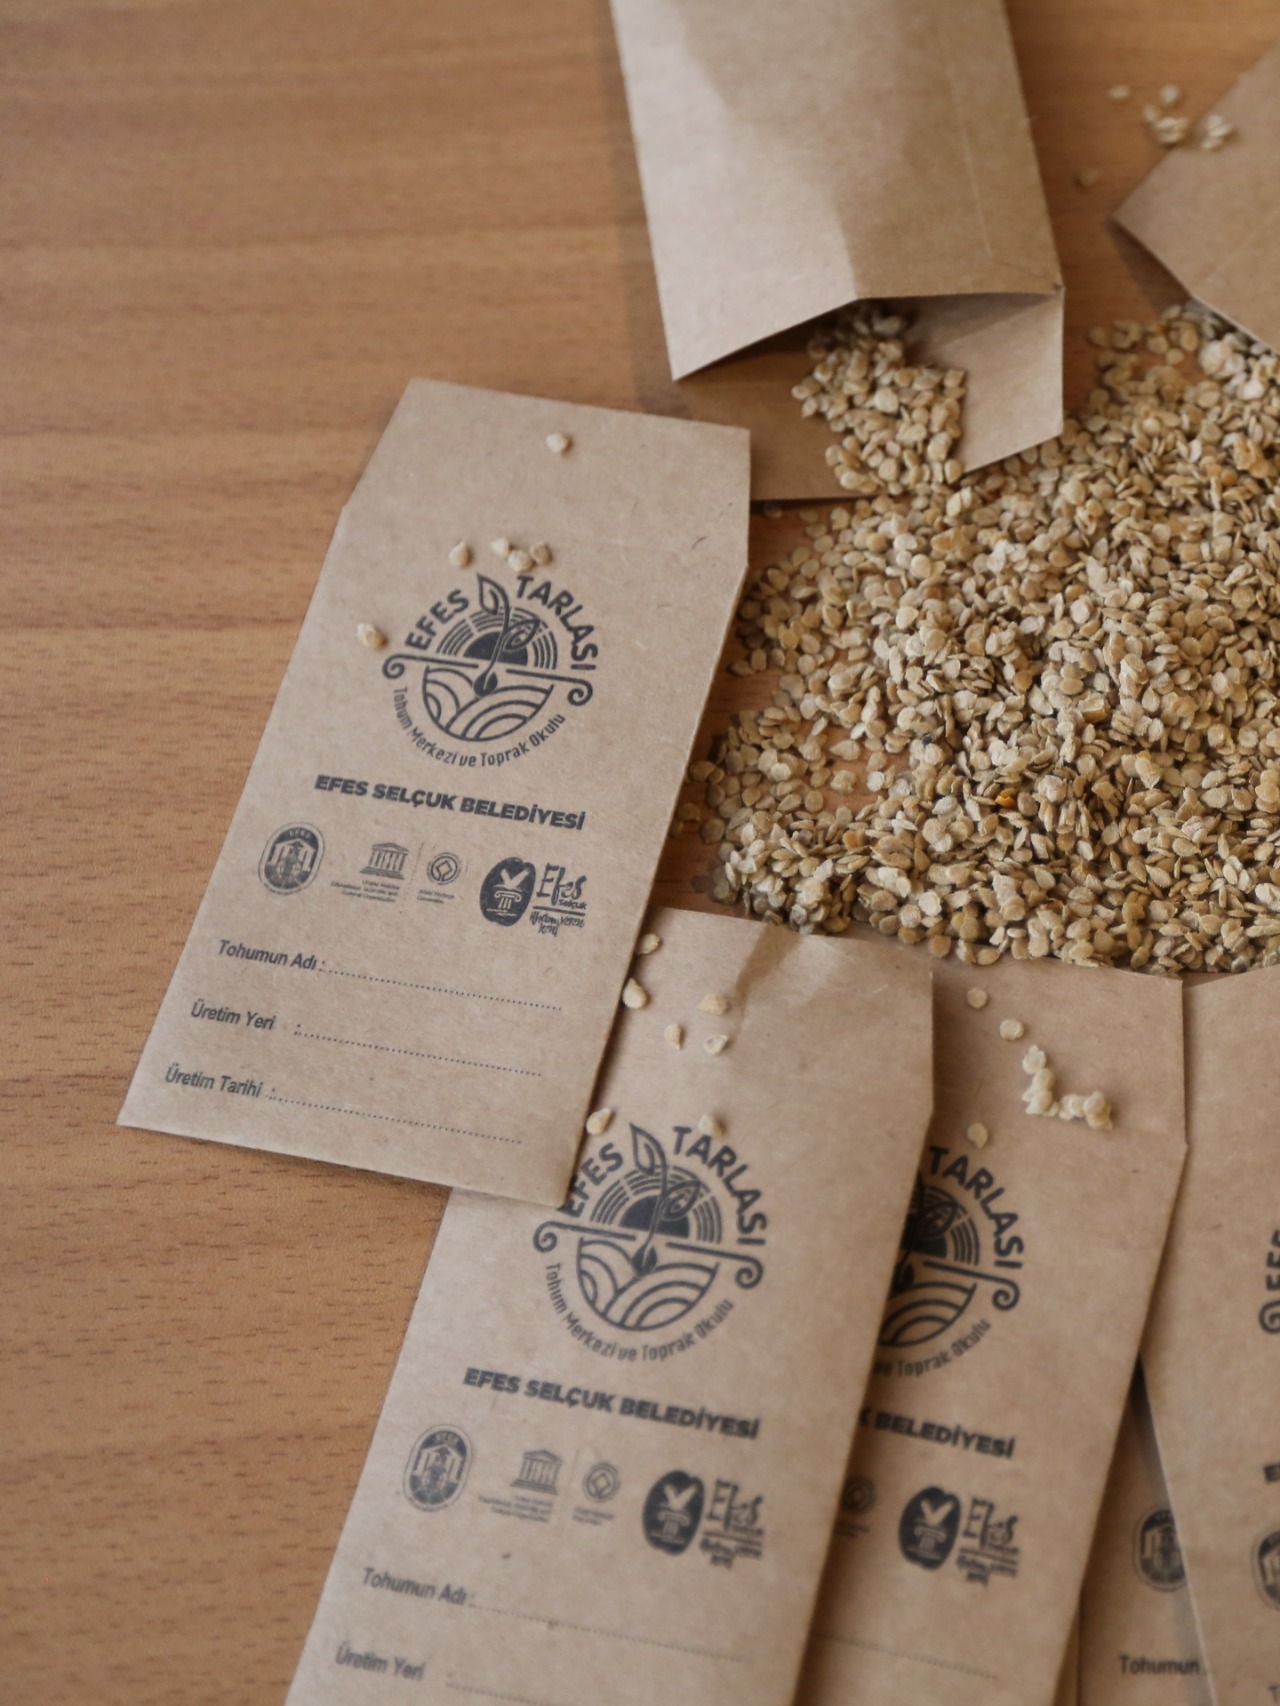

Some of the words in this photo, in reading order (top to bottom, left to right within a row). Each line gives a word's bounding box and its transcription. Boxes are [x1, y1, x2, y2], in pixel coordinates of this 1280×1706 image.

[404, 588, 470, 651] EFES
[516, 575, 599, 670] TARLASI
[393, 686, 413, 730] Tohum
[409, 726, 457, 765] Merkezi
[459, 756, 477, 767] ve
[480, 741, 531, 767] Toprak
[528, 713, 566, 748] Okulu
[314, 774, 368, 796] EFES
[371, 784, 458, 811] SELÇUK
[460, 797, 587, 831] BELEDİYESİ
[536, 862, 587, 906] Efes
[219, 940, 288, 965] Tohumun
[191, 998, 241, 1025] Üretim
[245, 1011, 276, 1031] Yeri
[165, 1062, 215, 1090] Üretim
[220, 1075, 263, 1098] Tarihi
[556, 1142, 623, 1218] EFES
[673, 1126, 767, 1245] TARLASI
[929, 1146, 1024, 1269] TARLASI
[546, 1262, 569, 1314] Tohum
[564, 1311, 614, 1359] Merkezi
[463, 1367, 520, 1394] EFES
[525, 1378, 616, 1414] SELÇUK
[619, 1397, 761, 1440] BELEDİYESİ
[873, 1410, 1015, 1459] BELEDİYESİ
[363, 1567, 437, 1599] Tohumun
[335, 1640, 388, 1673] Üretim
[393, 1656, 426, 1681] Yeri
[1119, 1654, 1200, 1676] Tohumun
